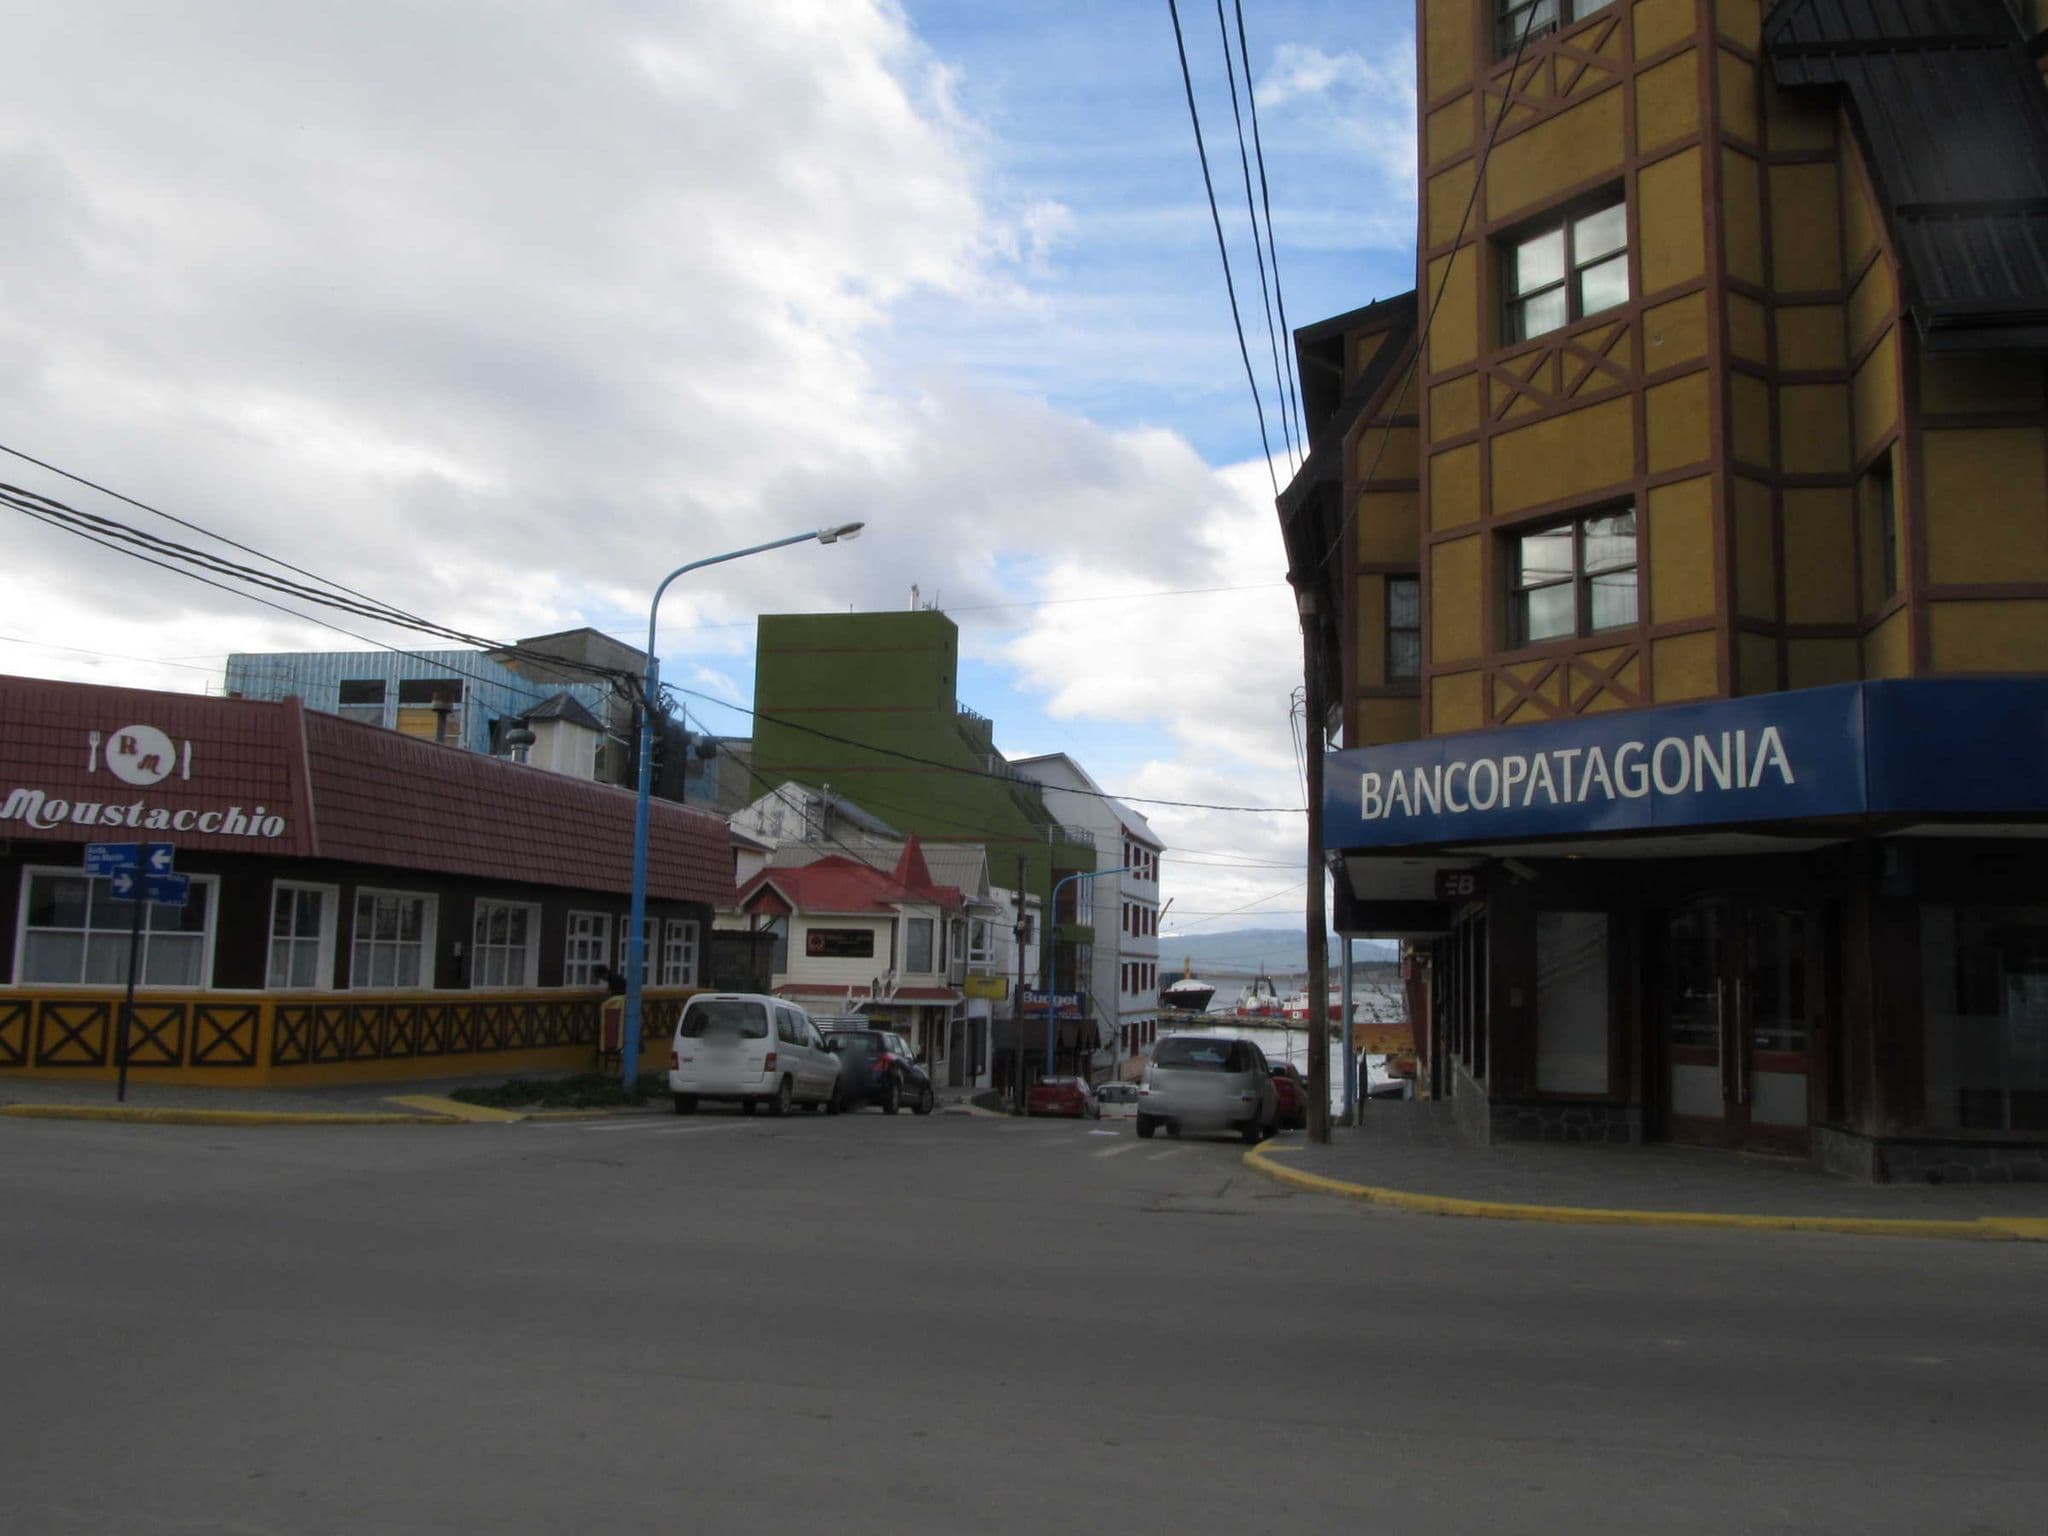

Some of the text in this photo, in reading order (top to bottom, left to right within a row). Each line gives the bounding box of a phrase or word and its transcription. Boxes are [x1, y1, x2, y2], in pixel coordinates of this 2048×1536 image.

[119, 735, 138, 755] R
[1360, 725, 1795, 821] BANCOPATAGONIA
[0, 788, 286, 838] Moustacchio
